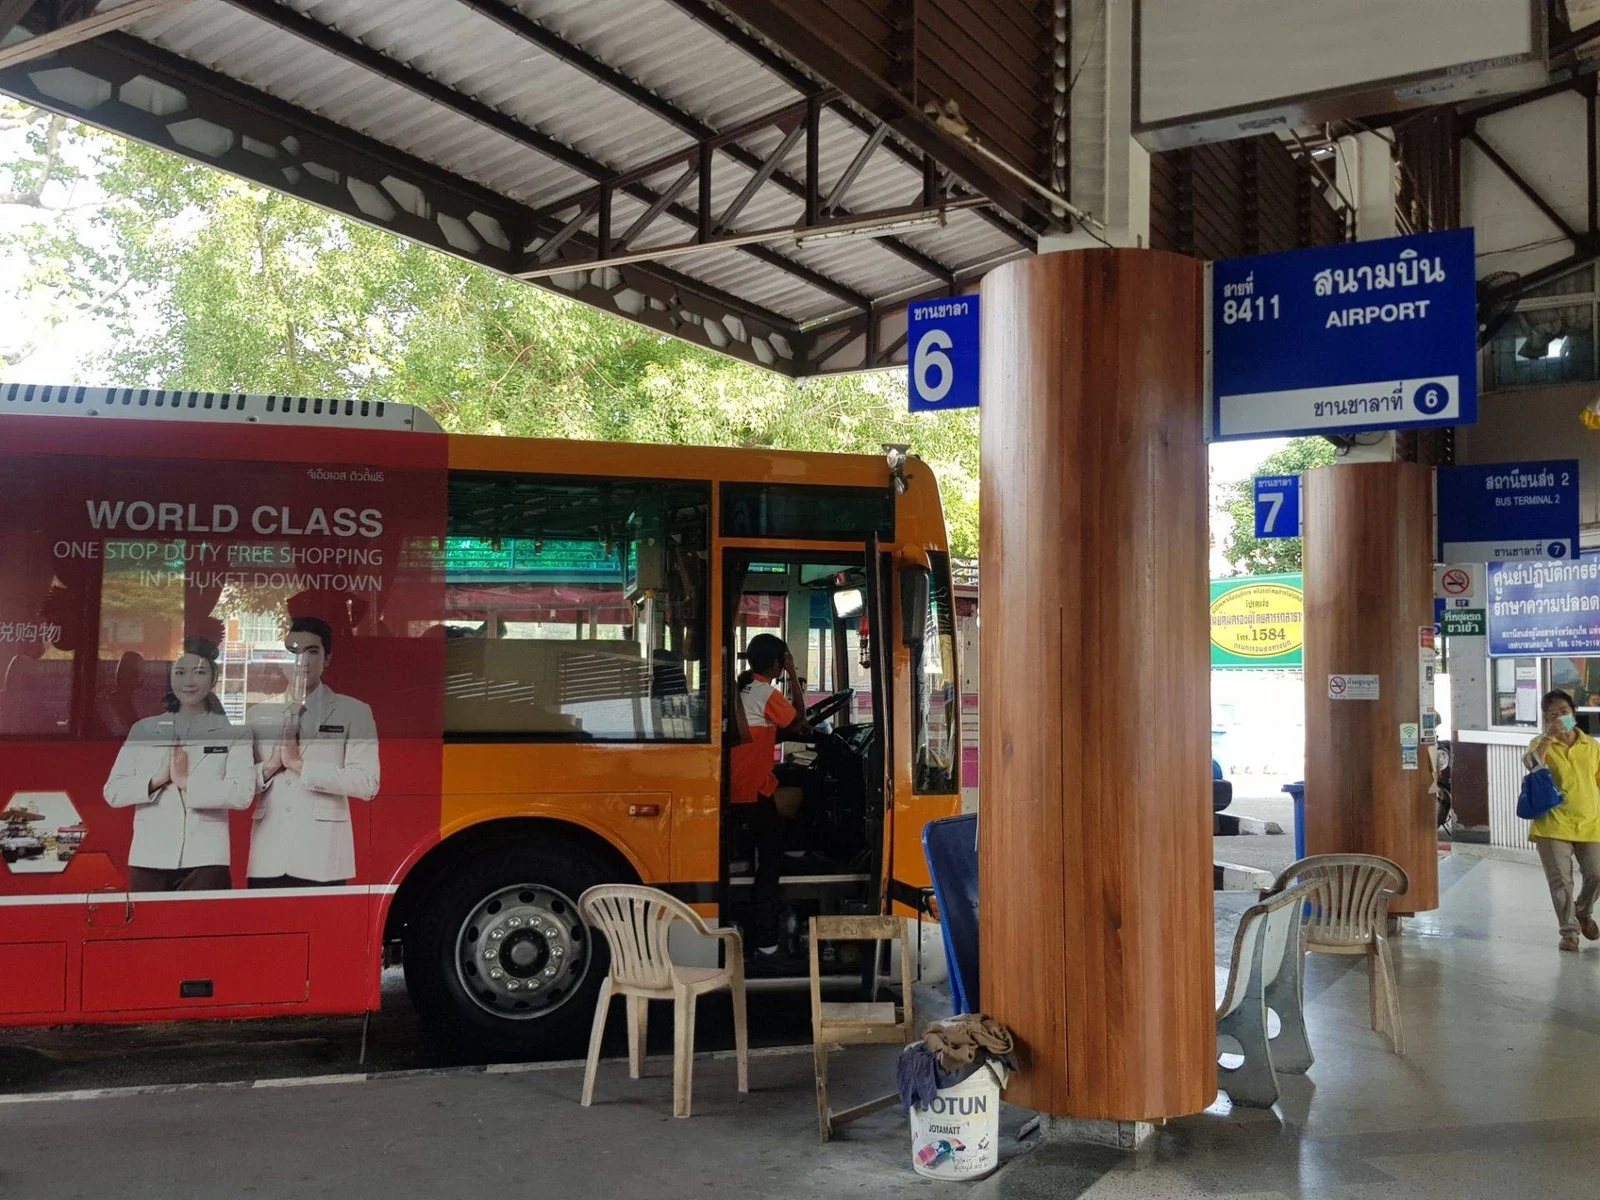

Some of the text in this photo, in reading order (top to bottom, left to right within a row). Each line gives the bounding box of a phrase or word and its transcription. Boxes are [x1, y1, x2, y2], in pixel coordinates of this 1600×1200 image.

[1223, 271, 1255, 297] สายที่
[1313, 248, 1445, 297] สนามบิน
[913, 303, 969, 321] ชานชาลา
[1223, 295, 1281, 325] 8411
[1325, 300, 1431, 329] AIRPORT
[913, 329, 954, 403] 6
[1313, 382, 1439, 418] ชานชาลาที่ 6
[1485, 468, 1571, 490] สถานีขนส่ง 2
[1258, 492, 1284, 533] 7
[1495, 494, 1561, 507] BUS TERMINAL 2
[85, 500, 384, 538] WORLD CLASS
[52, 540, 384, 567] ONE STOP DUTY FREE SHOPPING
[139, 570, 383, 593] IN PHUKET DOWNTOWN
[1493, 557, 1600, 595] ศูนย์ปฏิบัติการร่
[1252, 628, 1286, 641] 1584
[928, 1123, 961, 1136] JOTAMATT
